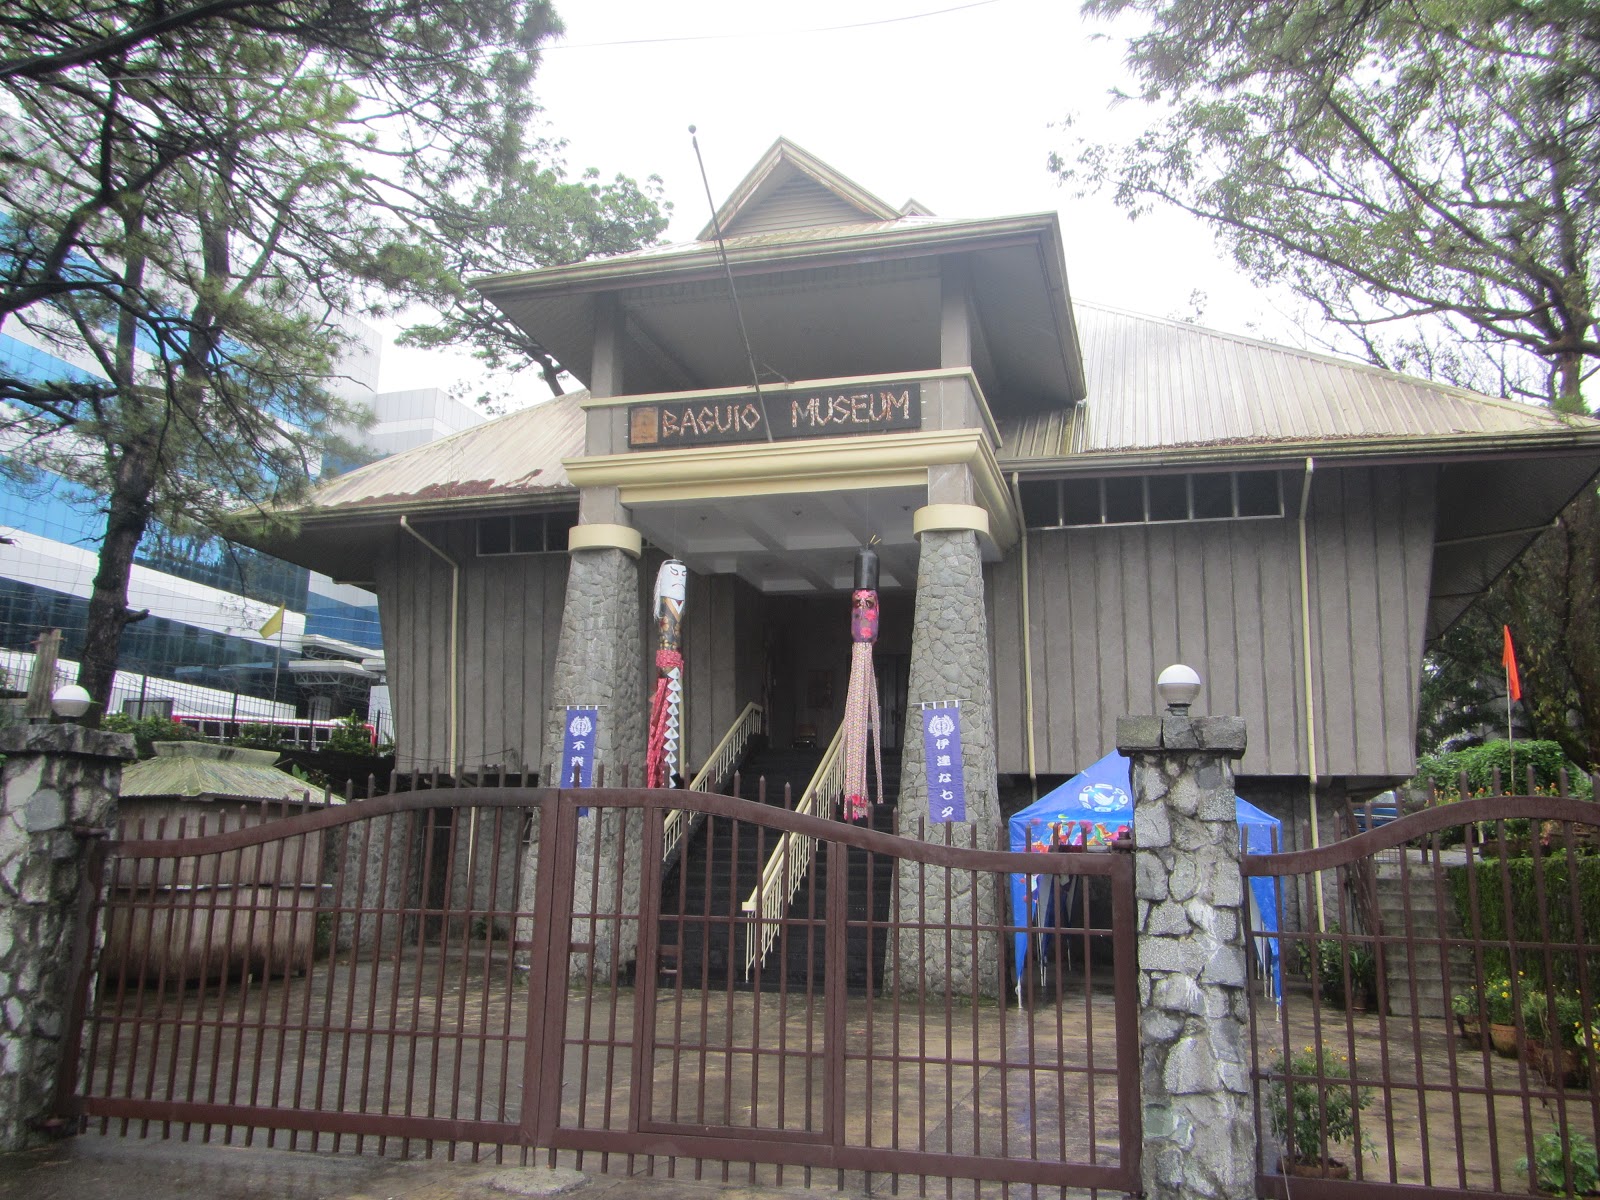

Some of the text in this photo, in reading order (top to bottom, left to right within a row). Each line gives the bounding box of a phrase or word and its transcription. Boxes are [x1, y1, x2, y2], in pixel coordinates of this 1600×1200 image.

[662, 390, 910, 438] BAGUIO MUSEUM
[935, 738, 954, 818] 伊達な七夕
